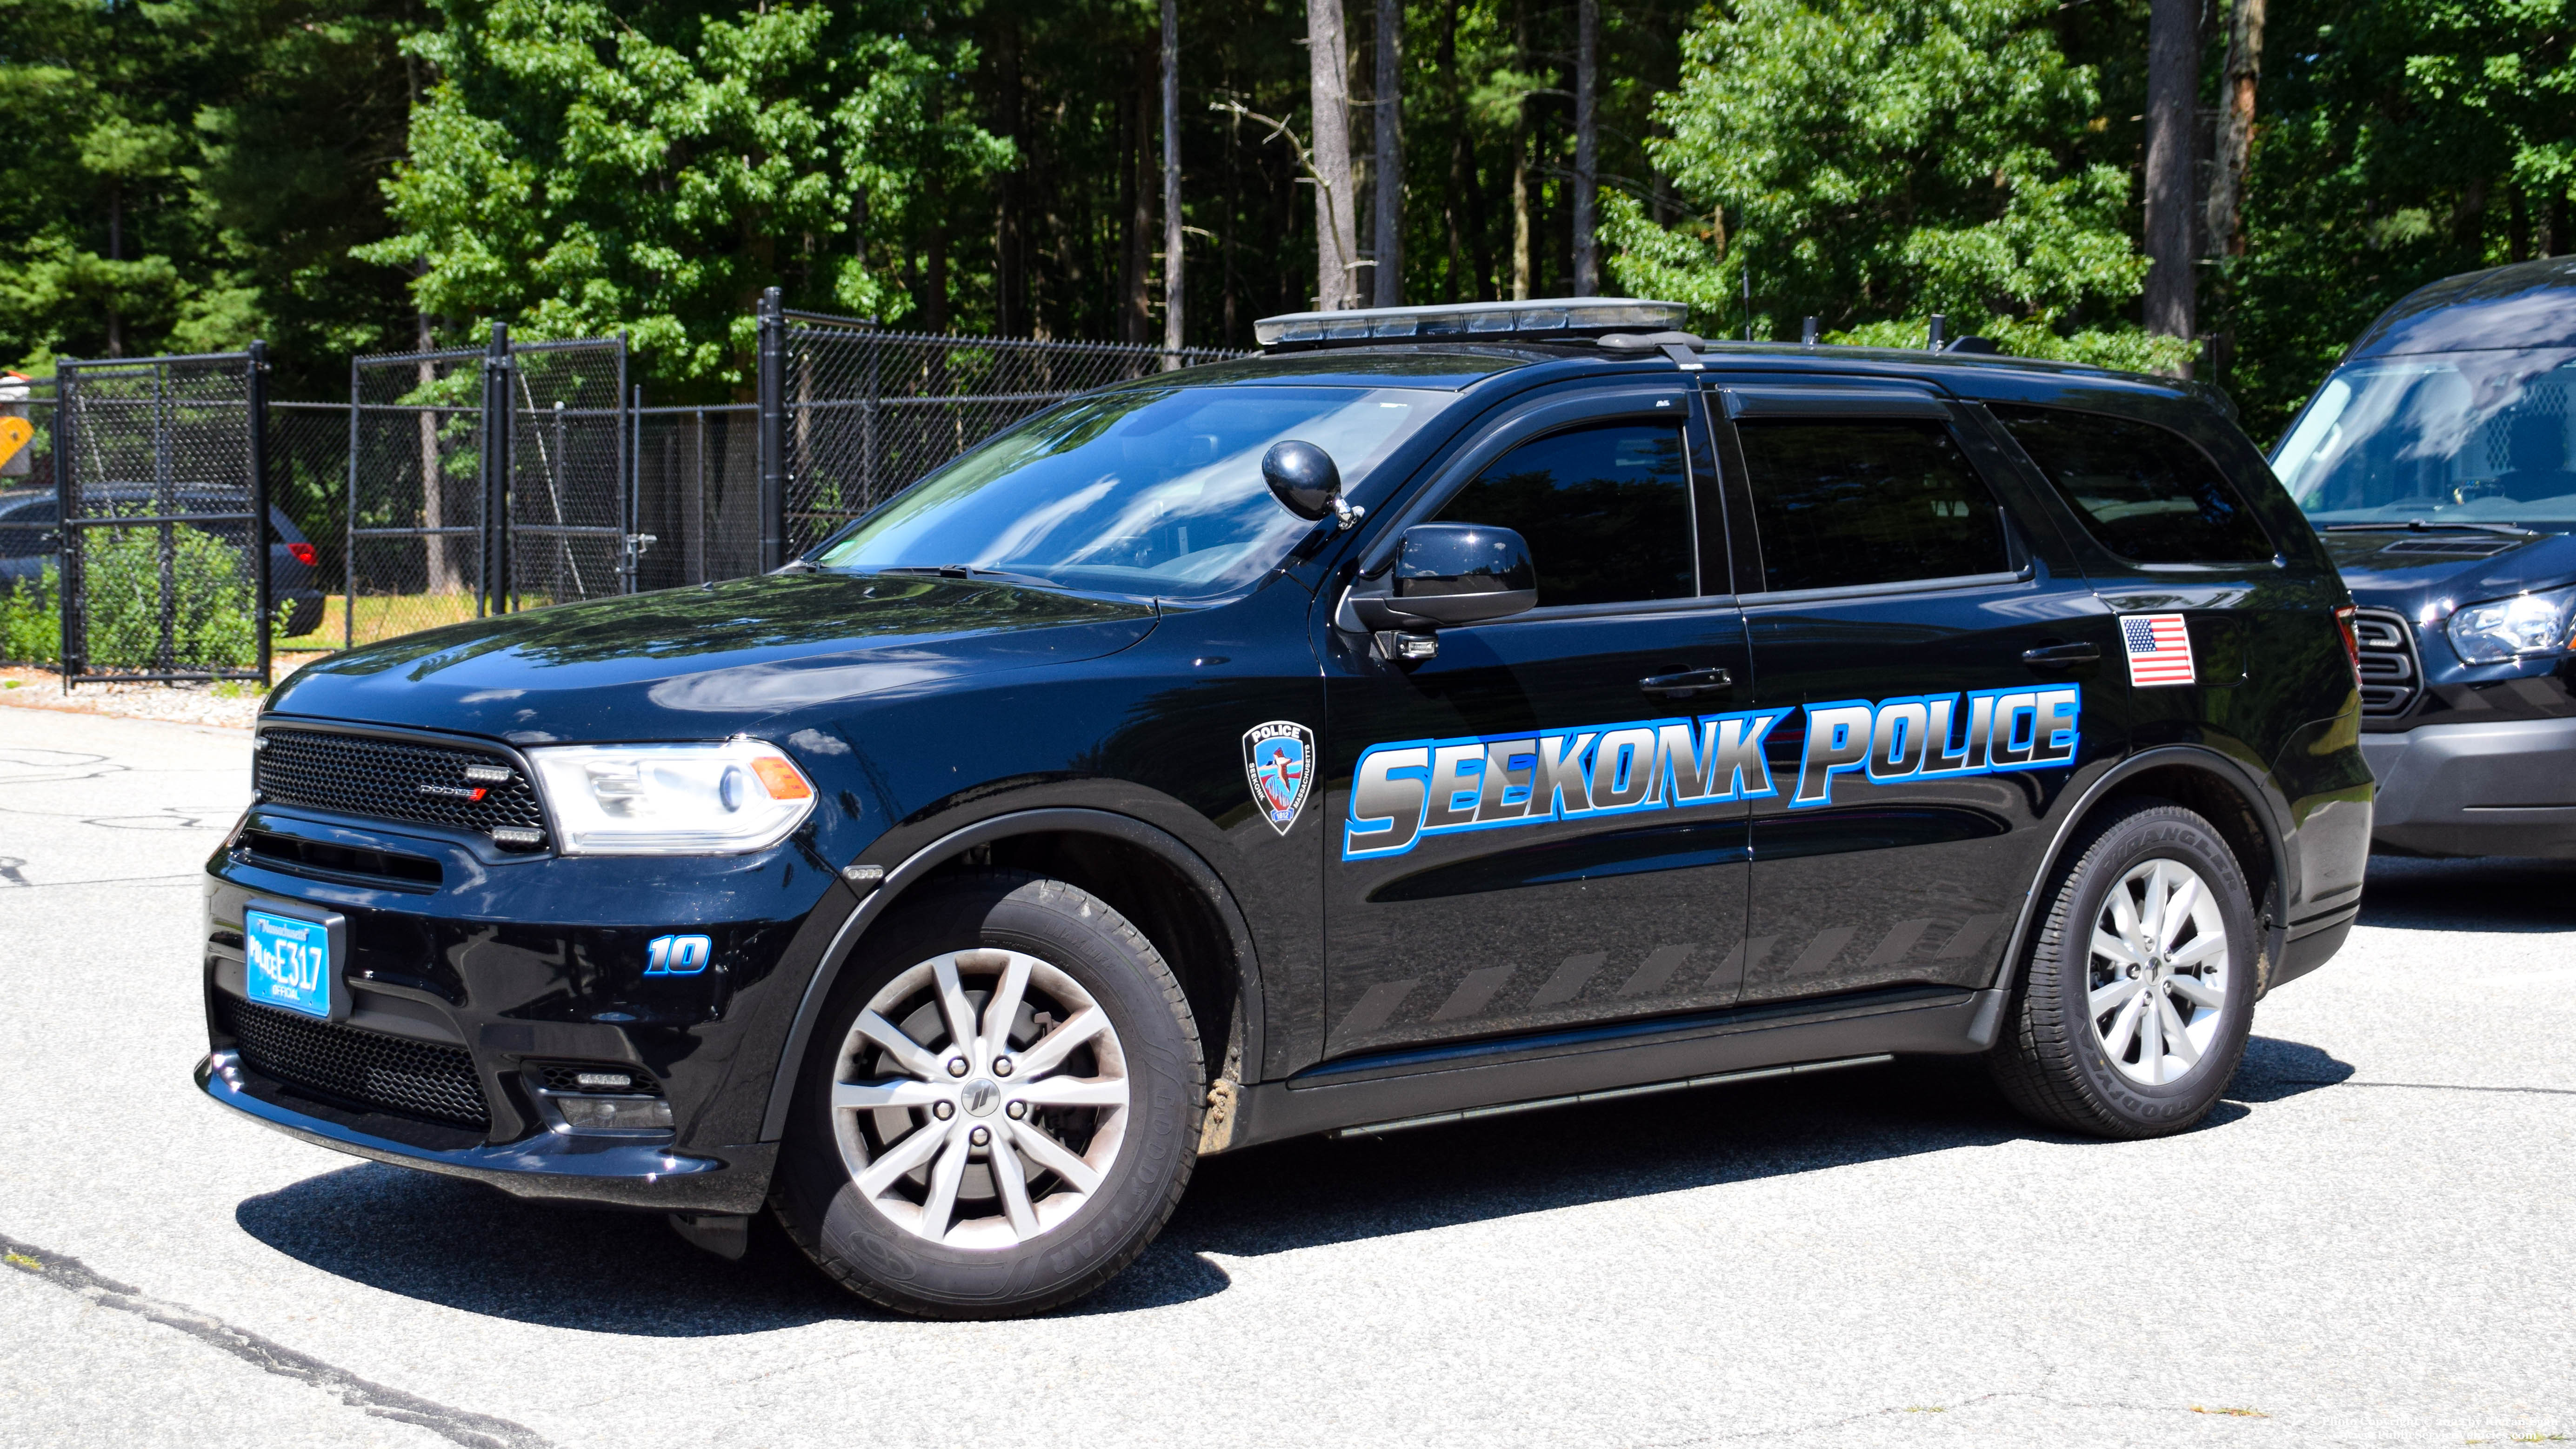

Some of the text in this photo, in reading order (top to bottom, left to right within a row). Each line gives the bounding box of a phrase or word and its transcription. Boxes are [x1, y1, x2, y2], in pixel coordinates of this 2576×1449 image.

[1251, 724, 1301, 743] POLICE
[420, 784, 477, 797] DODGE
[1249, 762, 1265, 801] SEEKONK
[1293, 744, 1310, 809] MASSACHUSETTS
[1343, 684, 2079, 860] SEEKONK POLICE
[262, 919, 307, 941] Massachusetts
[250, 935, 322, 992] POLICE E317
[644, 935, 711, 973] 10
[273, 984, 300, 1001] OFFICIAL
